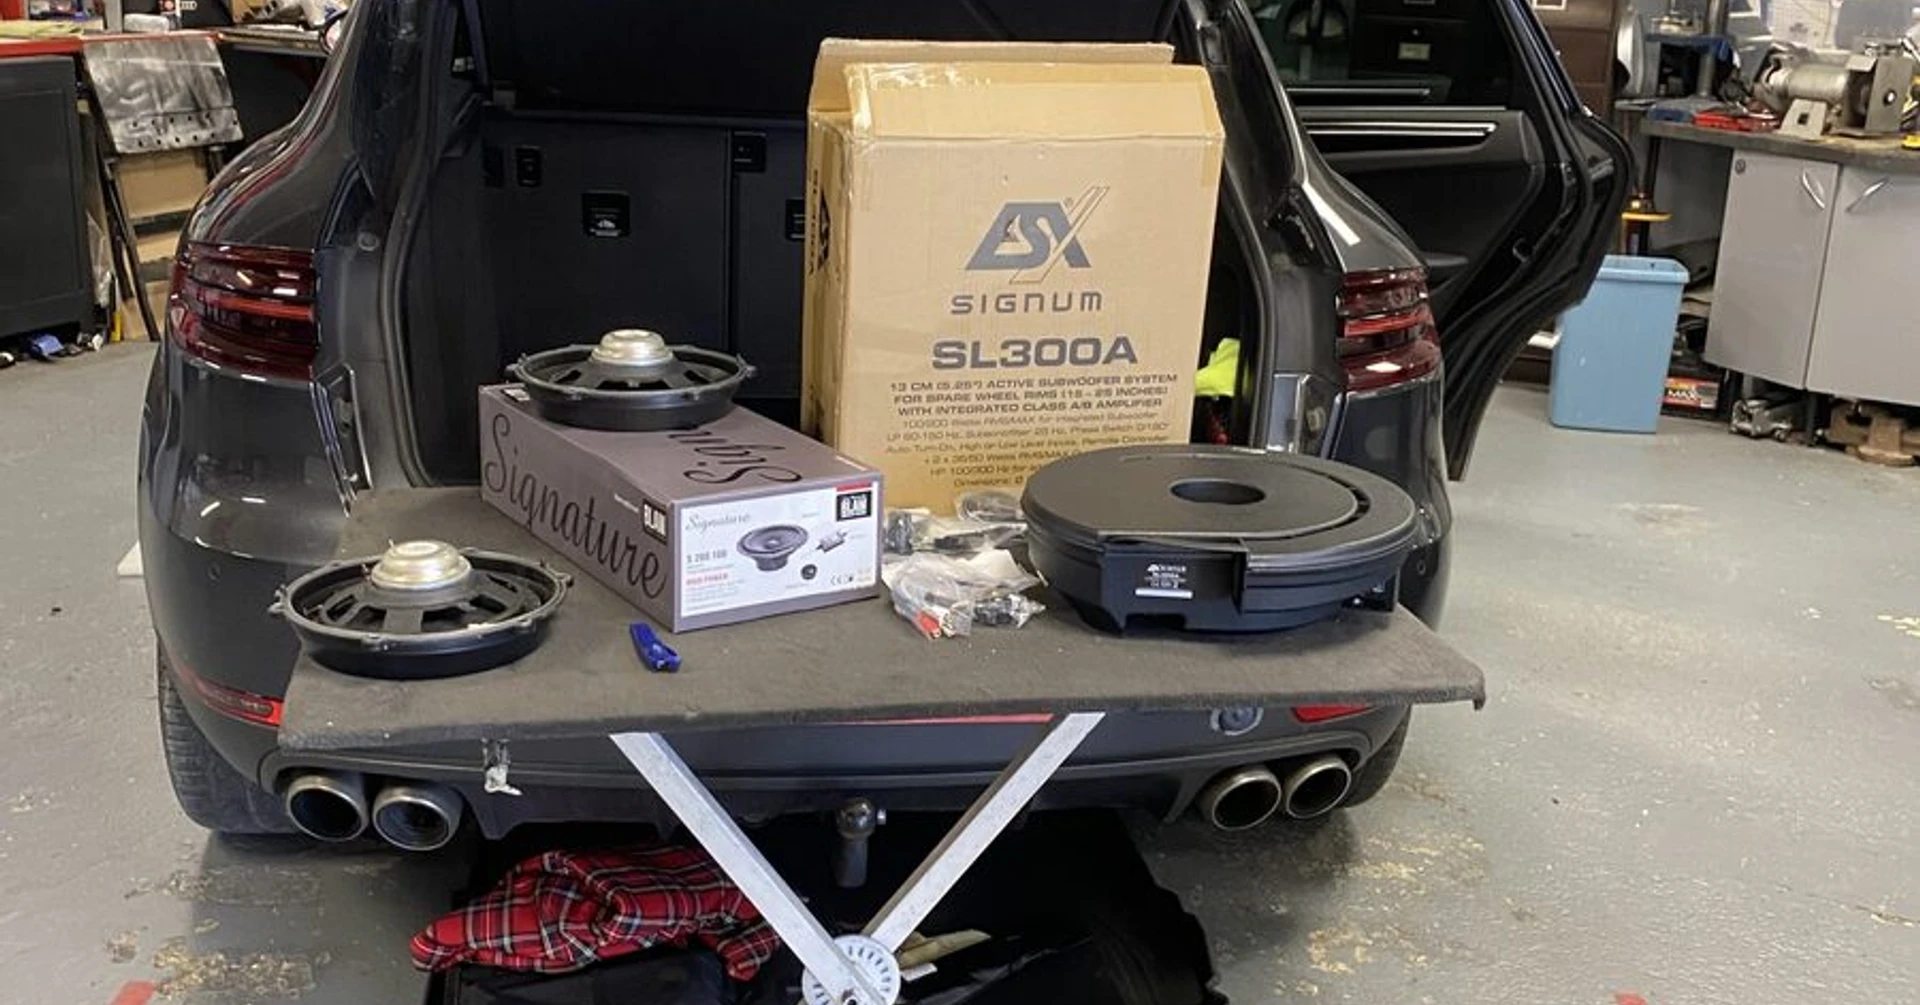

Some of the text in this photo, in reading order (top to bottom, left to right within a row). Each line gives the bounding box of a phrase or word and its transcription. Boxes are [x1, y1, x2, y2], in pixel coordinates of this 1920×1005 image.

[951, 290, 1102, 316] SIGNUM
[932, 335, 1138, 370] SL300A
[911, 382, 933, 391] CM
[986, 378, 1034, 389] ACTIVE
[1039, 375, 1121, 387] SUBWOOFER
[1124, 374, 1178, 385] SYSTEM
[894, 393, 923, 405] FOR
[926, 392, 971, 403] SPARE
[975, 391, 1020, 401] WHEEL
[1023, 389, 1057, 400] RIMS
[898, 405, 933, 416] WITH
[936, 402, 1019, 415] INTEGRATED
[1022, 401, 1066, 412] CLASS
[1096, 397, 1163, 409] AMPLIFIER
[484, 413, 668, 599] Signature
[685, 513, 752, 535] Signature
